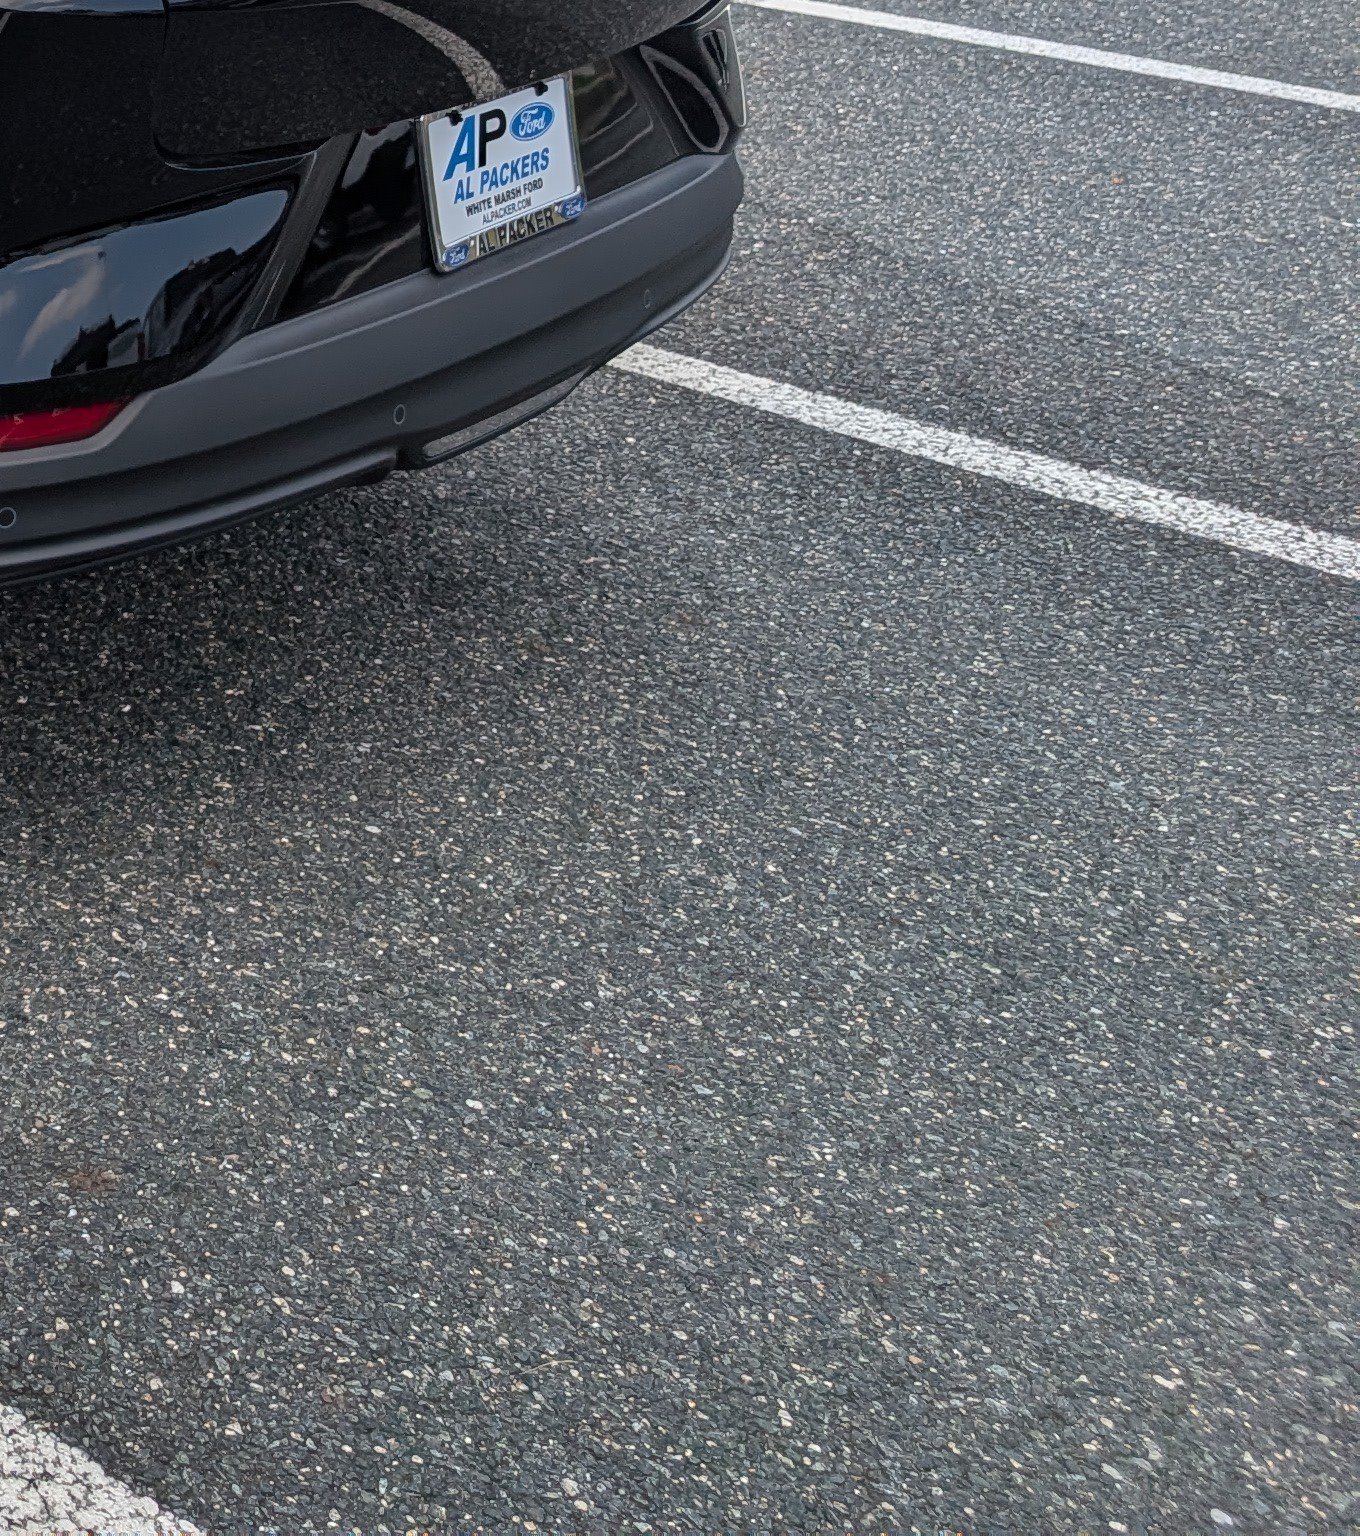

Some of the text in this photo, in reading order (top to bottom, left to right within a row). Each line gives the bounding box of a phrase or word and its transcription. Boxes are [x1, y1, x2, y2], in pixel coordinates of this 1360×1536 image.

[516, 106, 549, 139] Ford
[443, 108, 507, 182] AP
[453, 146, 550, 205] AL PACKERS
[465, 177, 544, 218] WHITE MARSH FORD
[481, 196, 533, 226] ALPACKER.COM
[496, 205, 556, 248] PACKER
